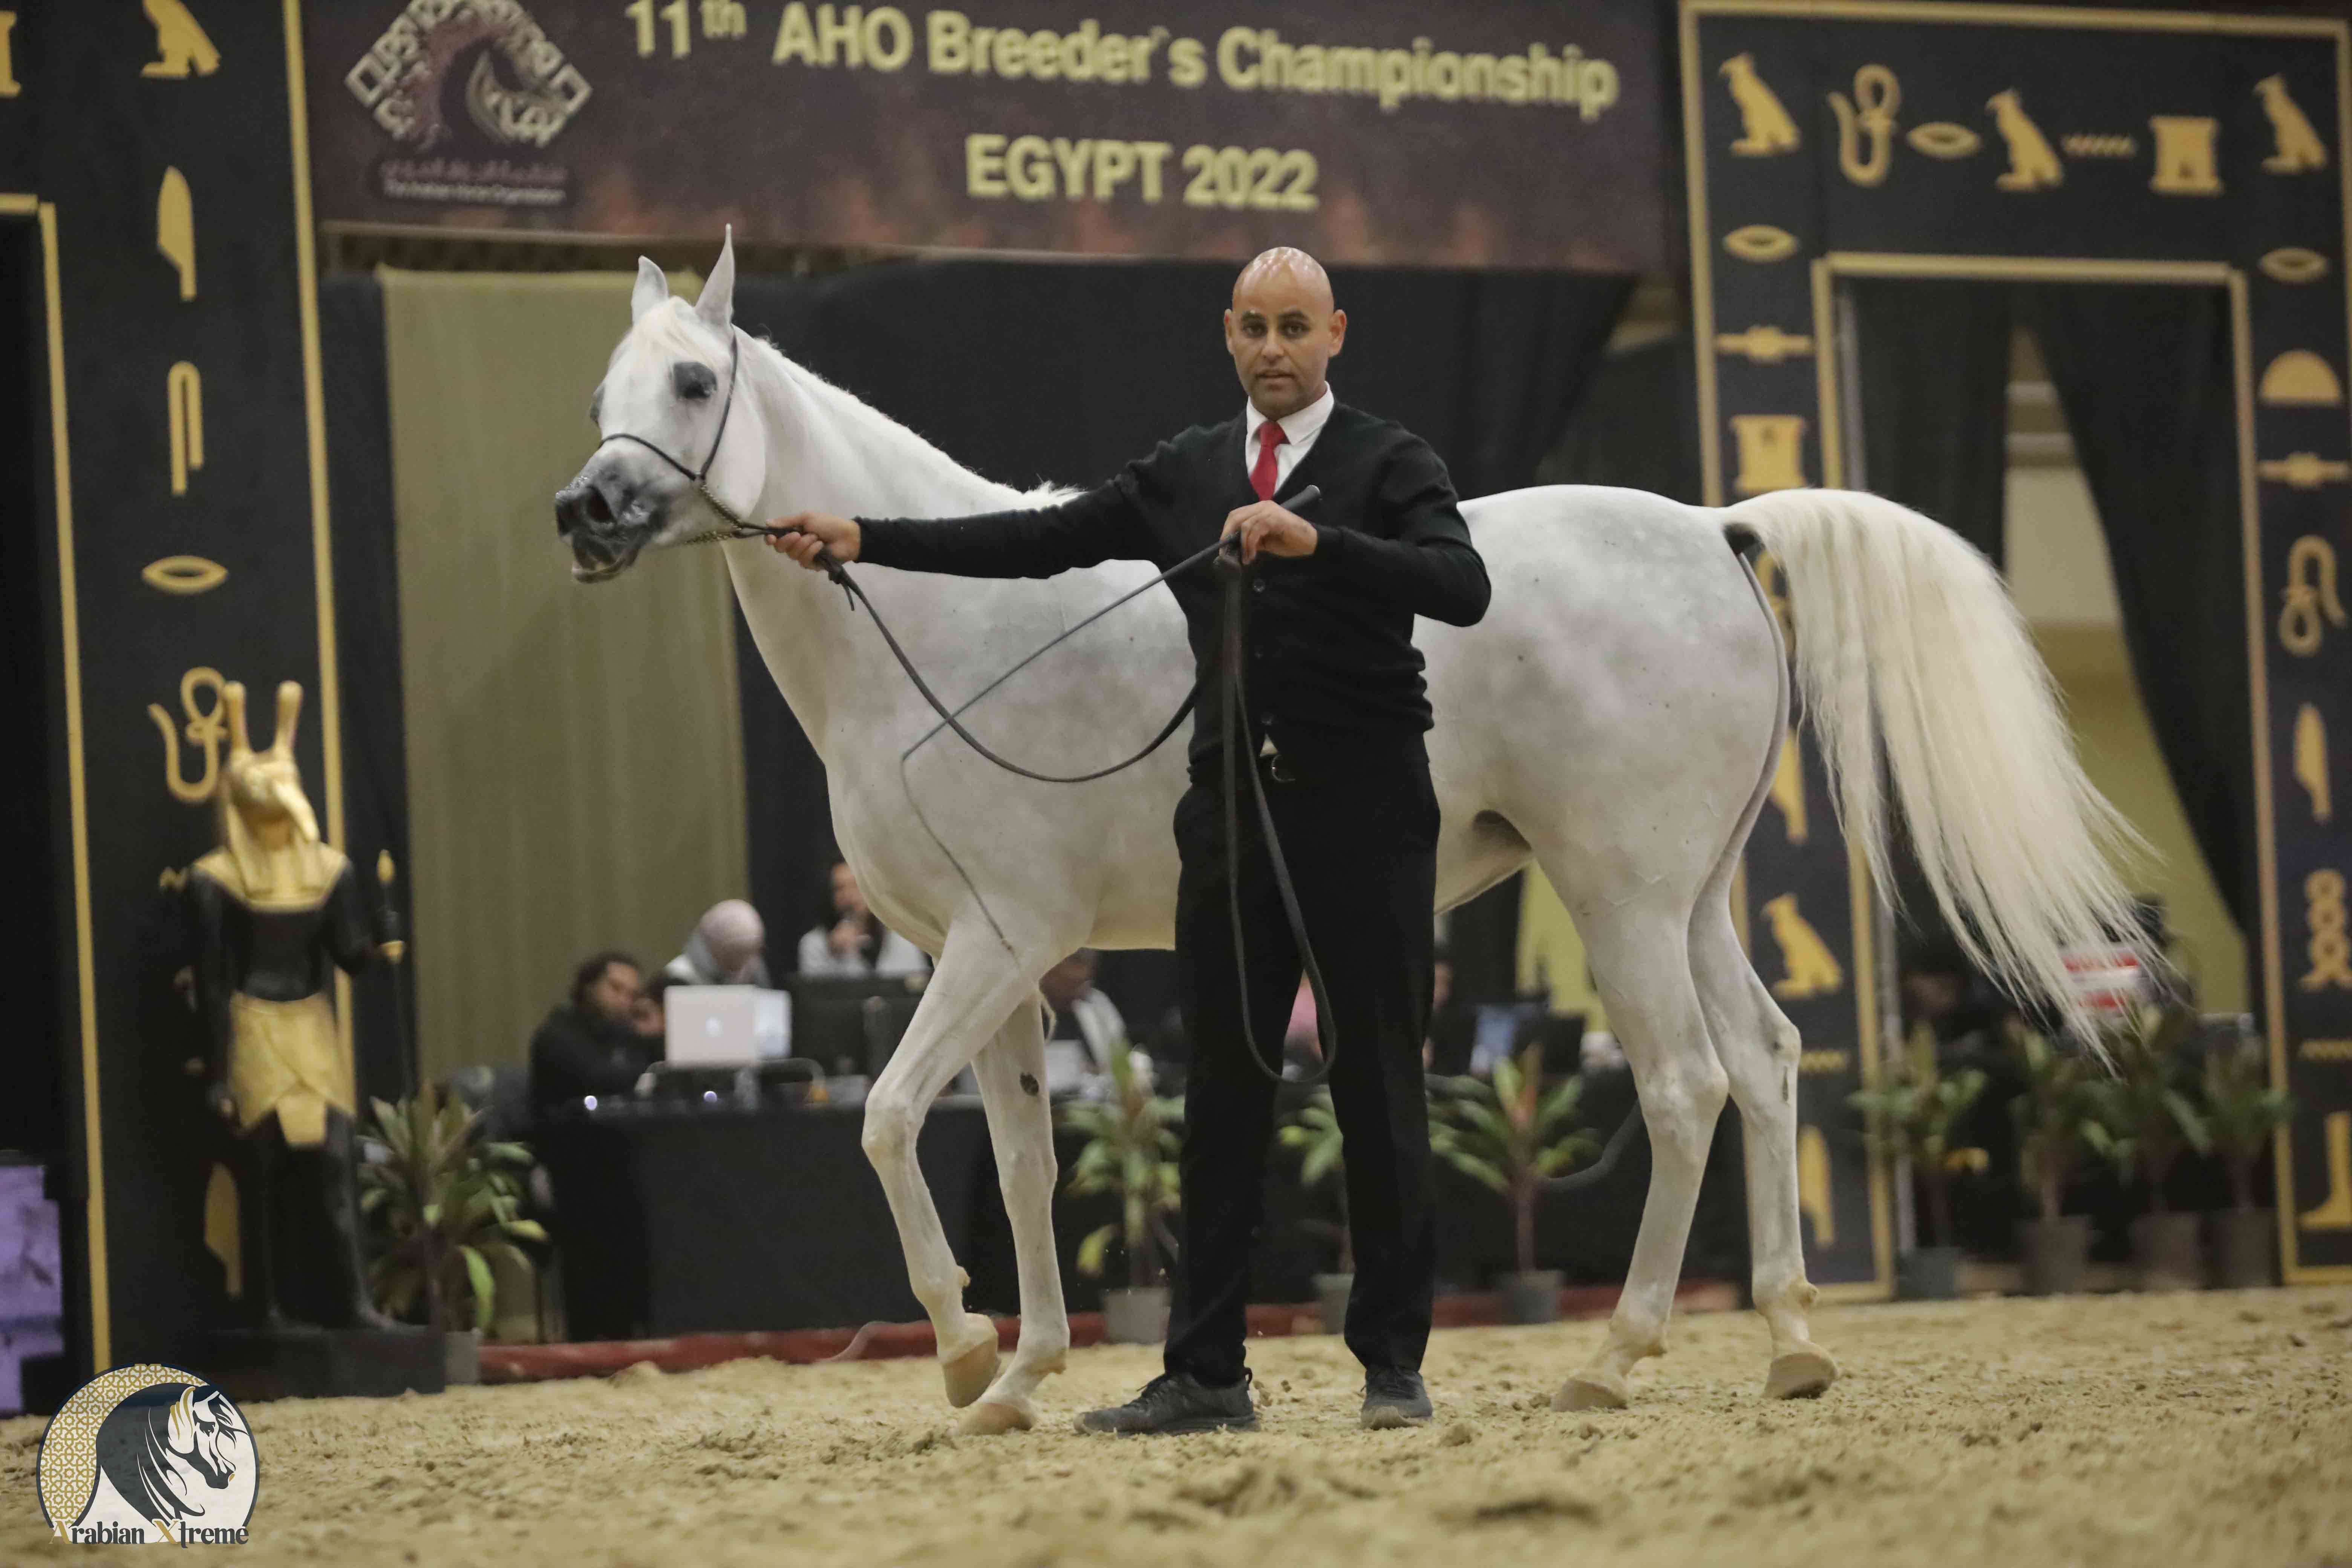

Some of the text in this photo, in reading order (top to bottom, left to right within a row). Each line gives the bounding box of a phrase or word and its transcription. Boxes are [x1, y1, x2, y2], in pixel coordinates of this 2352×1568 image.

[625, 0, 748, 58] 11th
[772, 2, 914, 72] AHO
[1217, 26, 1620, 122] Championship
[966, 133, 1319, 211] EGYPT 2022
